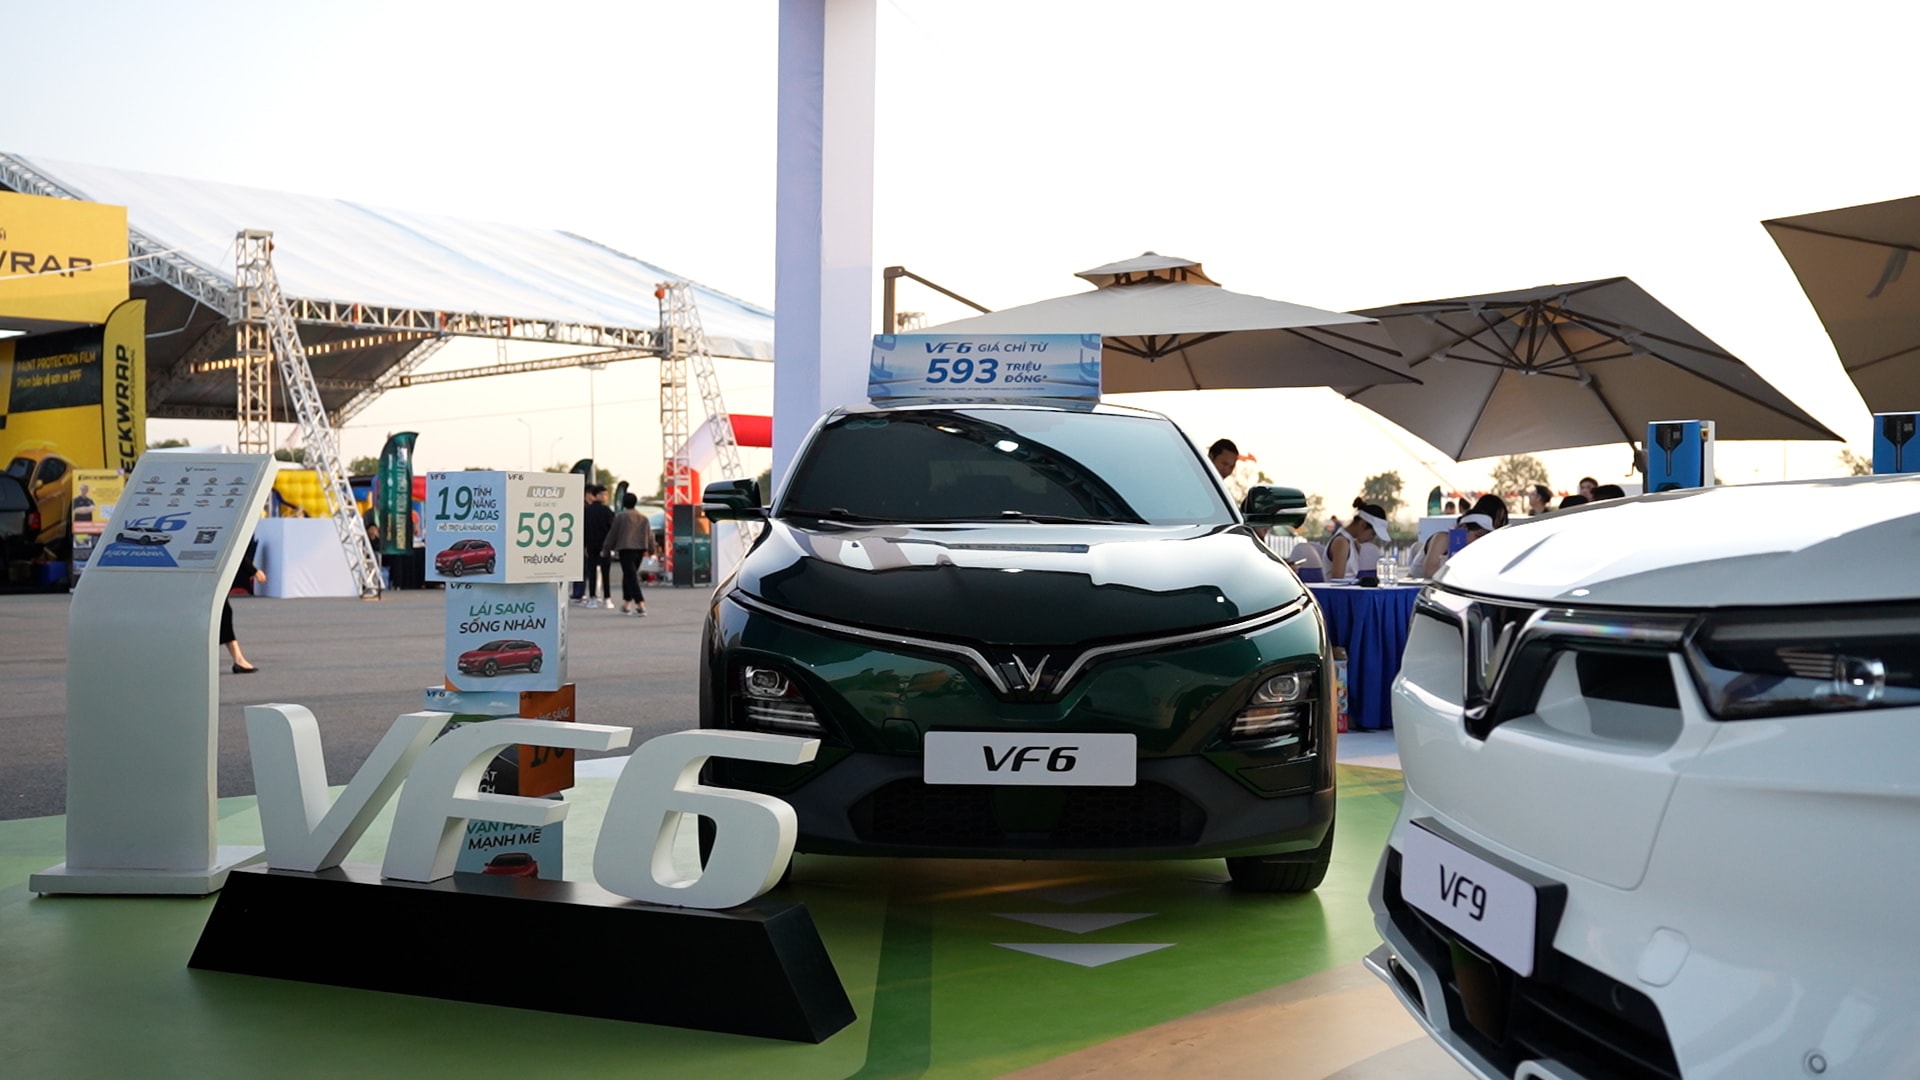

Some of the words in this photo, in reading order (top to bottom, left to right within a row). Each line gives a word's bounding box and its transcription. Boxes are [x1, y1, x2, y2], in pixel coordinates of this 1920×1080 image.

[978, 342, 1000, 353] GIÁ
[925, 358, 999, 384] 593
[1006, 361, 1042, 373] TRIỆU
[435, 485, 473, 521] 19
[473, 485, 492, 497] TÍNH
[471, 510, 500, 521] ADAS
[516, 512, 575, 548] 593
[469, 602, 493, 617] LÁI
[495, 601, 535, 615] SANG
[459, 617, 500, 634] SỐNG
[503, 615, 546, 632] NHÀN
[982, 745, 1080, 772] VF6
[244, 702, 821, 909] VF6
[468, 833, 516, 852] MẠNH
[519, 828, 542, 845] MẼ
[1439, 863, 1487, 922] VF9
